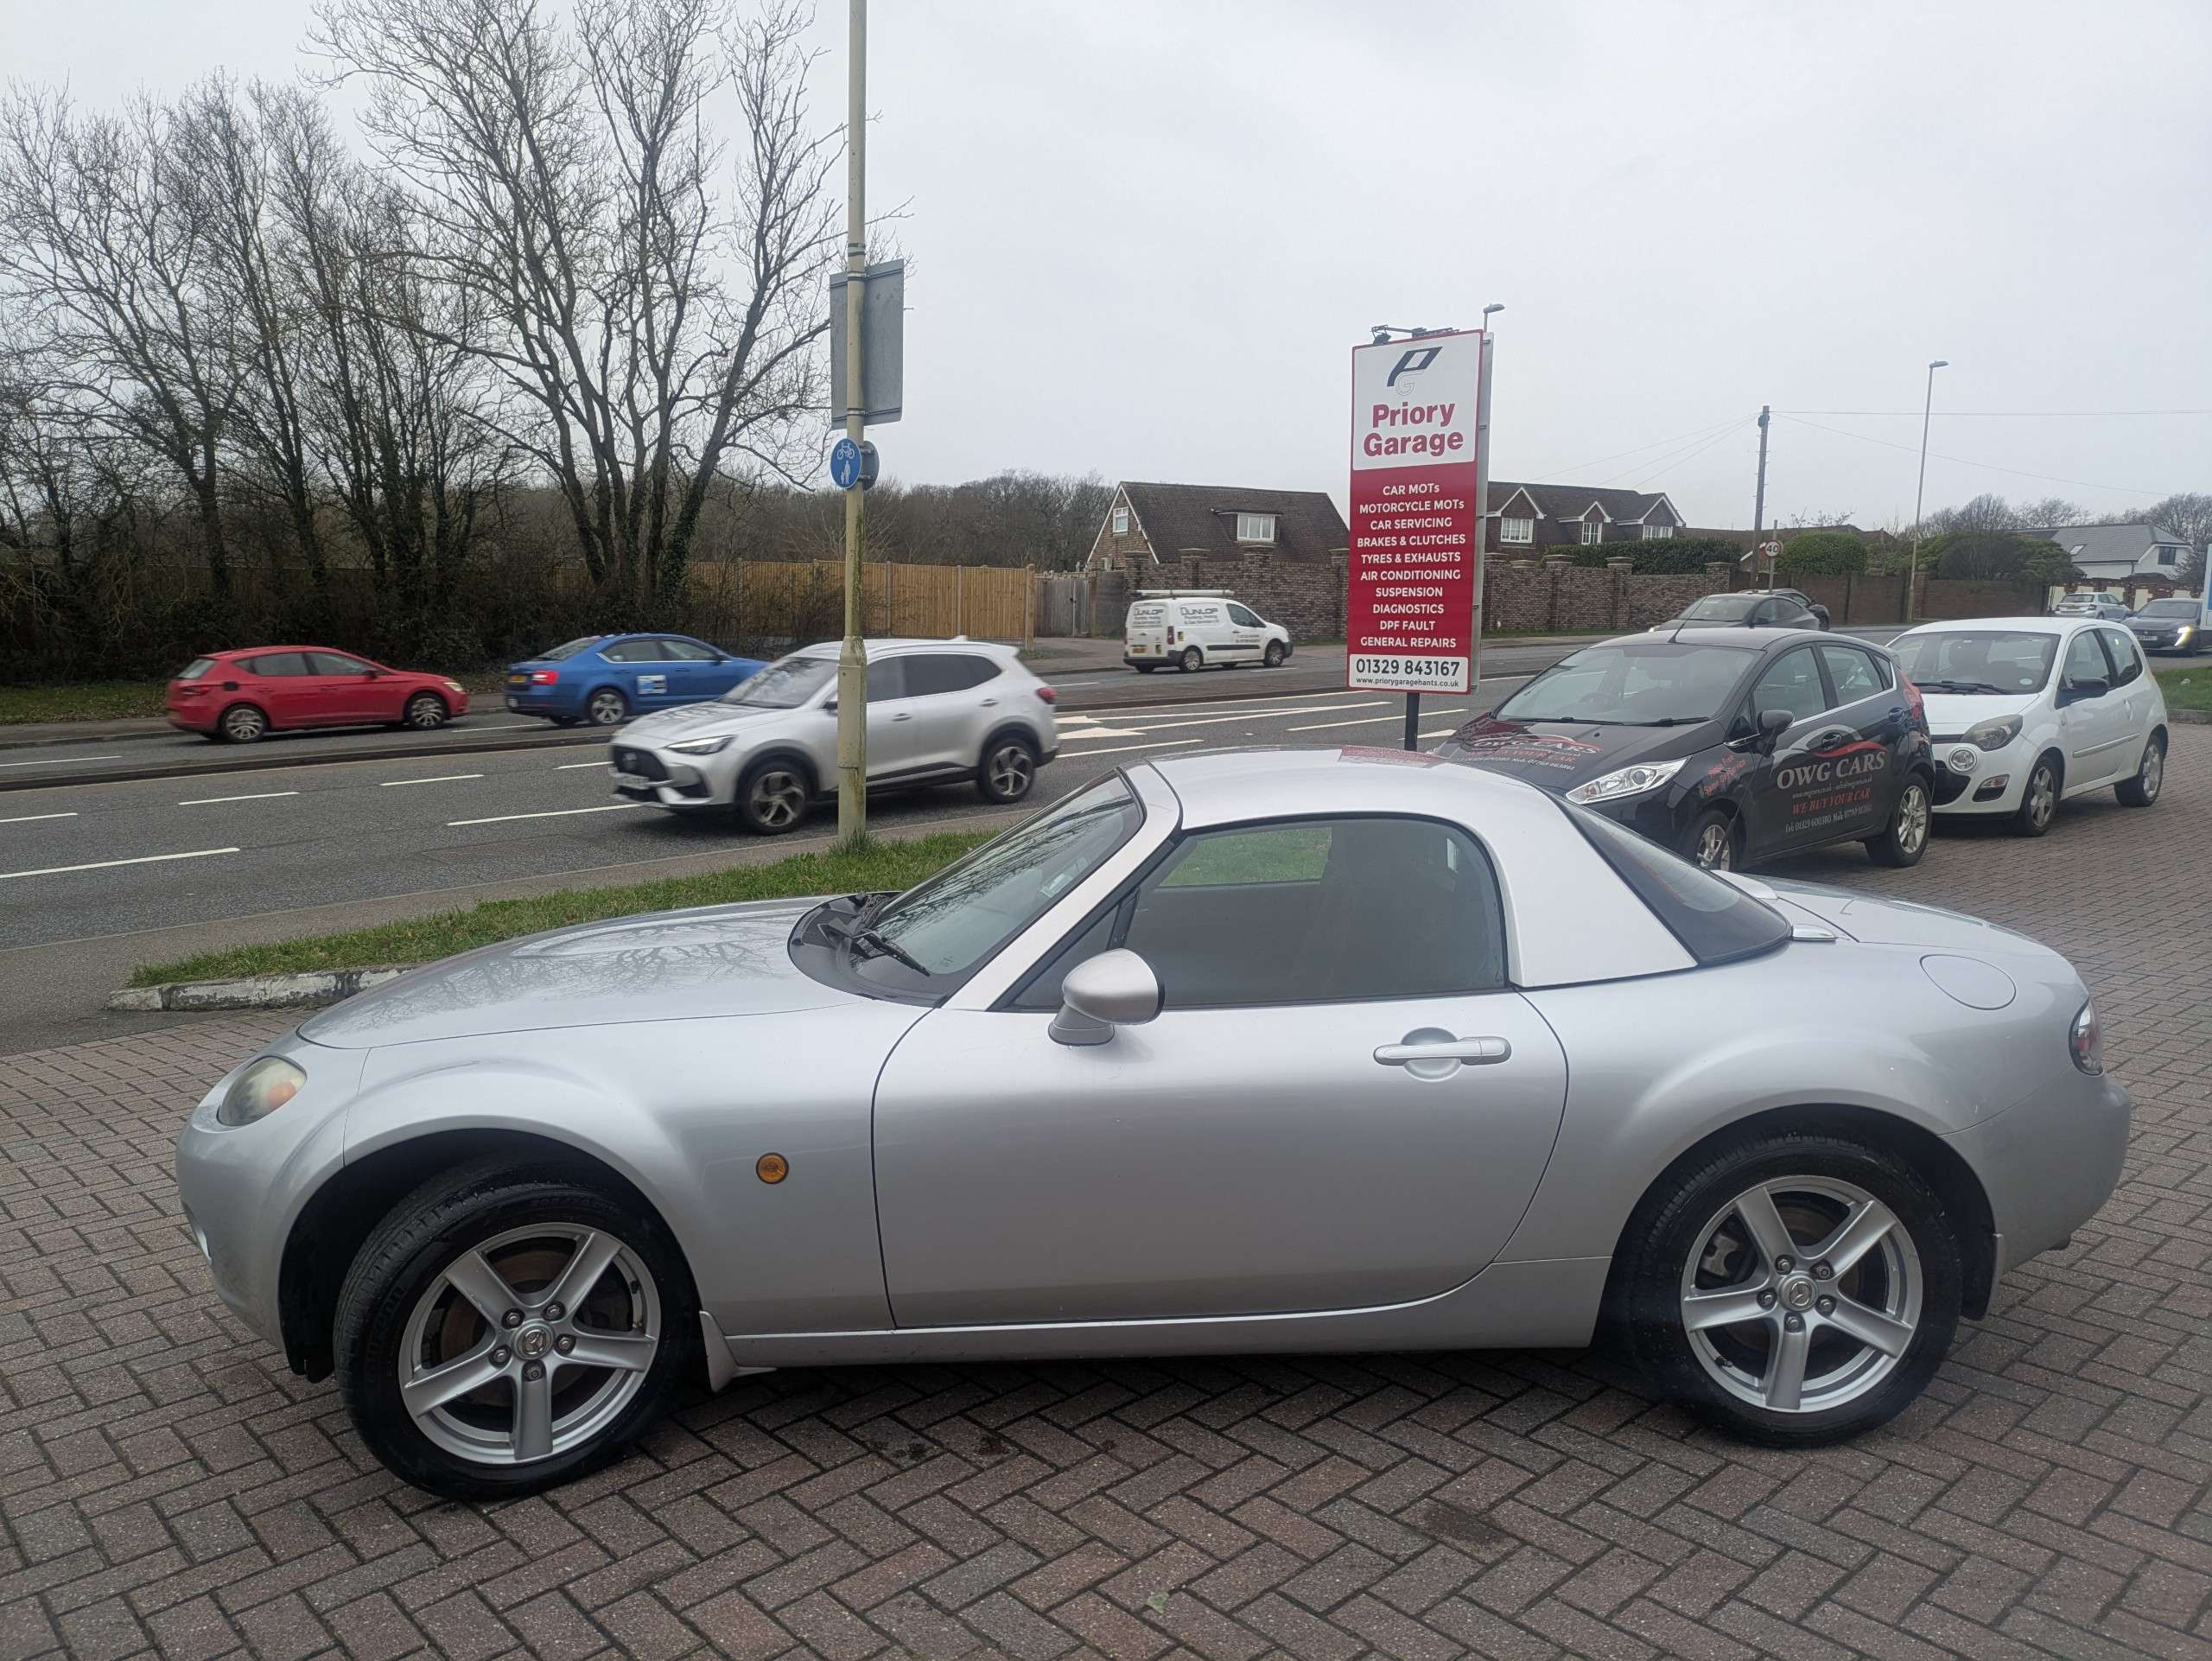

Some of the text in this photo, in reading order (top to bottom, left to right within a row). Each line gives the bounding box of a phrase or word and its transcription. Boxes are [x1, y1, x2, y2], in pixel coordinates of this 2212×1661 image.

[1372, 402, 1455, 428] Priory
[1363, 432, 1464, 456] Garage
[1382, 483, 1440, 495] CAR MOTs
[1359, 500, 1465, 514] MOTORCYCLE MOTs
[1370, 517, 1452, 531] CAR SERVICING
[1357, 534, 1466, 548] BRAKES & CLUTCHES
[1361, 551, 1461, 564] TYRES & EXHAUSTS
[1360, 570, 1461, 581] AIR CONDITIONING
[1376, 587, 1443, 597] SUSPENSION
[1179, 607, 1218, 616] DUNLOP
[1373, 604, 1445, 614] DIAGNOSTICS
[1380, 620, 1435, 631] DPF FAULT
[1360, 637, 1457, 648] GENERAL REPAIRS
[1356, 659, 1460, 677] 01329 843167
[1356, 678, 1459, 688] www.priorygaragehants.co.uk
[1777, 762, 1832, 789] OWG
[1835, 752, 1886, 777] CARS
[1829, 792, 1853, 806] YOUR
[1854, 788, 1872, 801] CAR
